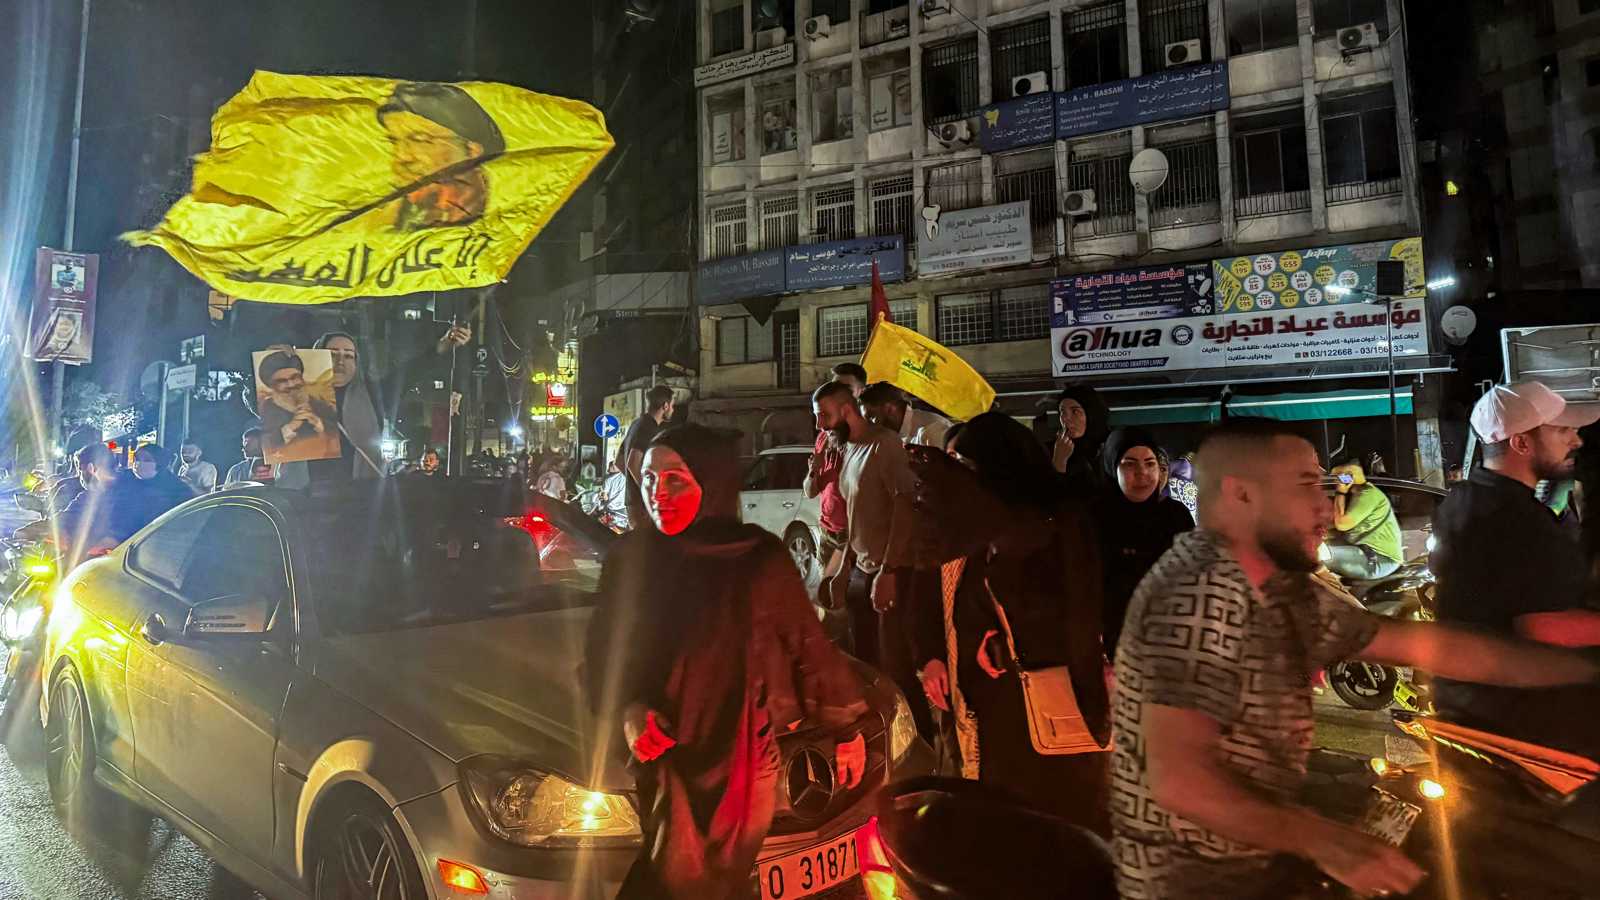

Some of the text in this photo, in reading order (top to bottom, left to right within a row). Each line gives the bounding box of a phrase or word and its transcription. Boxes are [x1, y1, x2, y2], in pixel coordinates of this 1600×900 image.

[1186, 64, 1223, 81] الدكتور
[1094, 86, 1123, 98] BASSAM
[992, 206, 1025, 224] الدكتور
[789, 252, 810, 264] بسام
[1074, 274, 1114, 289] التجارية
[1138, 267, 1185, 281] مؤسسة
[1333, 302, 1421, 330] مؤسسة
[1202, 317, 1274, 344] التجارية
[1088, 351, 1132, 359] TECHNOLOGY
[1360, 344, 1404, 355] 03/15633
[799, 837, 858, 890] 31871
